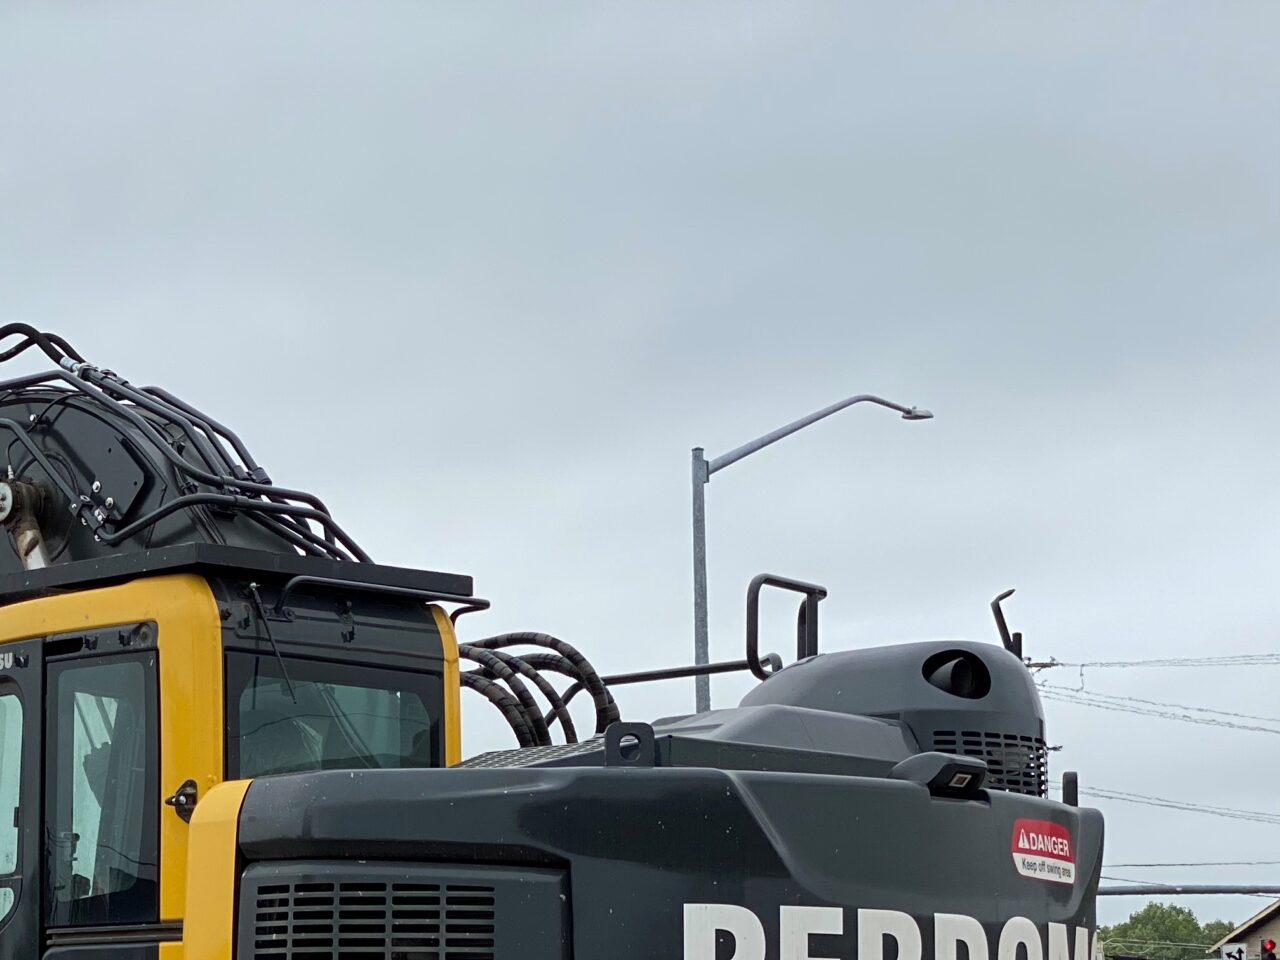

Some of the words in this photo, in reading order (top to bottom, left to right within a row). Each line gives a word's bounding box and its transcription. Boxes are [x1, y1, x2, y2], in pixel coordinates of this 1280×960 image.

[1029, 832, 1070, 857] DANGER
[1021, 857, 1038, 875] Keep
[1038, 861, 1046, 873] off
[1046, 863, 1062, 879] swing
[1061, 867, 1072, 878] area
